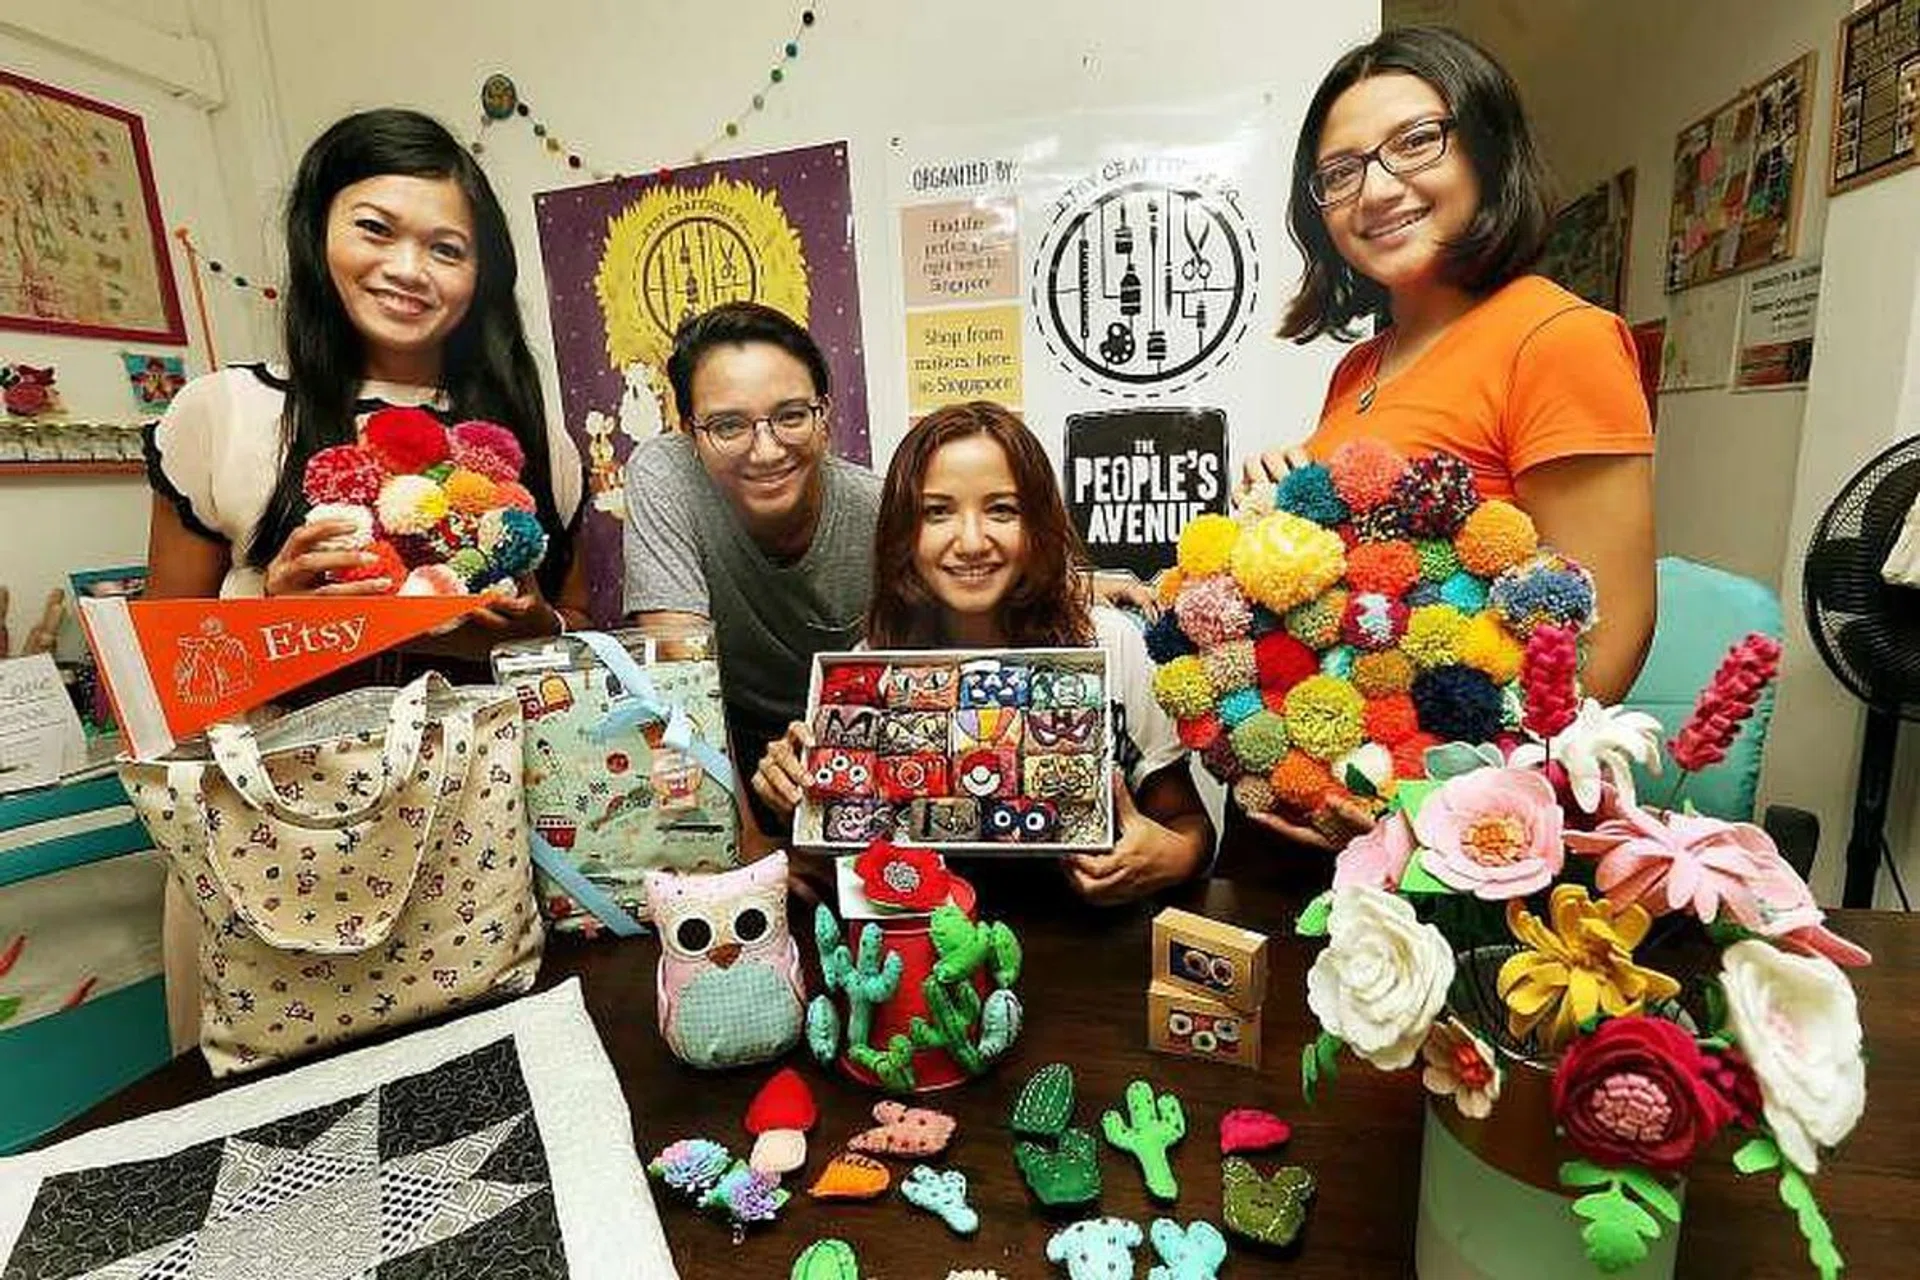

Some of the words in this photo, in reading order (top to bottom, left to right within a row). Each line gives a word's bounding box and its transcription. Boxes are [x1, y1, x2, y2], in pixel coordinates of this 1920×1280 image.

[966, 325, 1004, 343] from
[937, 376, 1014, 396] Singapore
[1074, 450, 1218, 503] PEOPLE'S
[260, 616, 367, 660] Etsy
